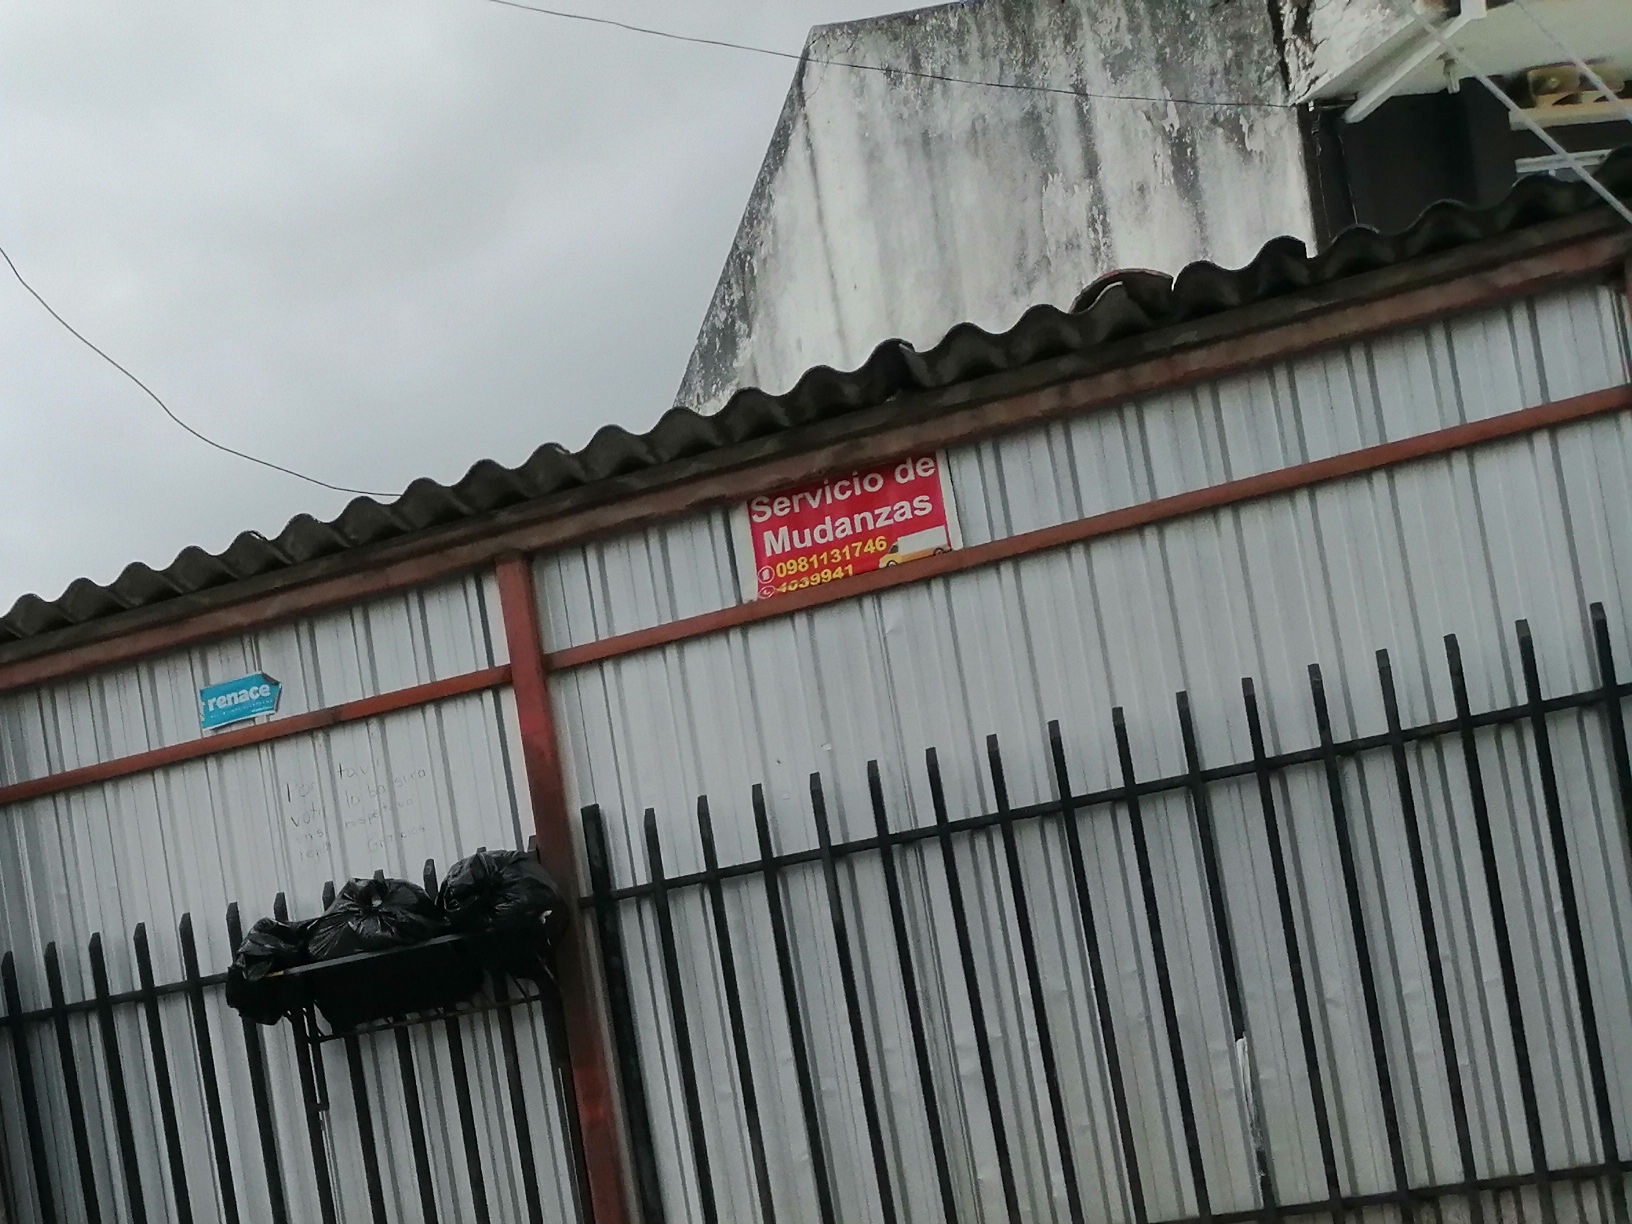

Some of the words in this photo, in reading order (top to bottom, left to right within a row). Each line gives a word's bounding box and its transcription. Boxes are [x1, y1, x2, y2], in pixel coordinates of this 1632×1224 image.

[750, 471, 884, 523] Servicio
[895, 457, 935, 484] de
[763, 494, 932, 557] Mudanzas
[775, 535, 887, 578] 0981131746
[207, 684, 271, 711] renace
